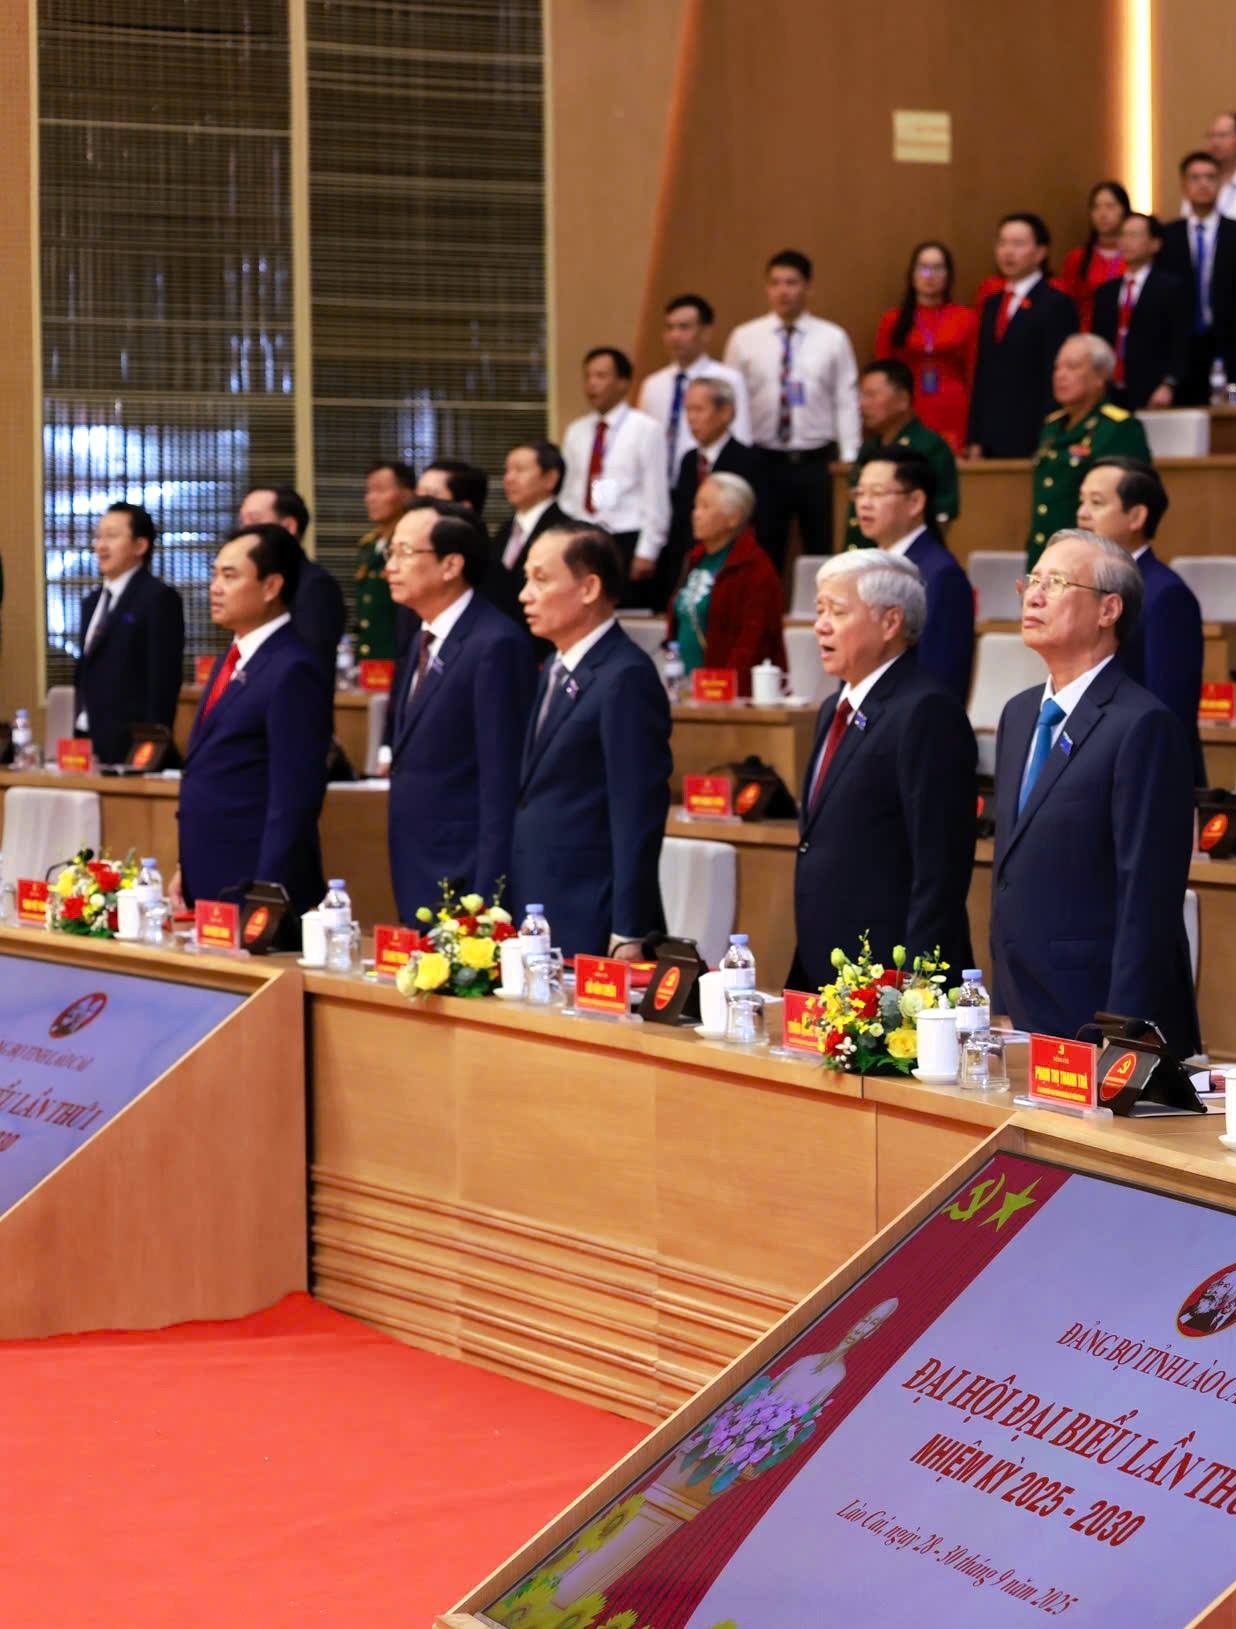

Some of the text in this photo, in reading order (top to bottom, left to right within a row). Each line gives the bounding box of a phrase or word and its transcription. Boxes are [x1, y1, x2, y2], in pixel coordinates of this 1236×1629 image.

[1056, 1320, 1118, 1357] ĐẢNG
[1103, 1338, 1145, 1371] BỘ
[1132, 1343, 1190, 1381] TỈNH
[1172, 1359, 1226, 1394] LÀO
[902, 1357, 971, 1404] ĐẠI
[947, 1374, 1022, 1423] HỘI
[998, 1393, 1073, 1441] ĐẠI
[1048, 1409, 1145, 1464] BIỂU
[1117, 1430, 1206, 1490] LẦN
[909, 1433, 994, 1482] NHIỆM
[973, 1456, 1026, 1494] KỲ
[1001, 1471, 1077, 1517] 2025
[1069, 1500, 1147, 1547] 2030
[836, 1499, 868, 1522] Lào
[861, 1510, 896, 1536] Cai,
[883, 1526, 921, 1551] ngày
[912, 1533, 944, 1555] 28
[936, 1544, 969, 1566] 30
[953, 1553, 999, 1587] tháng
[990, 1568, 1015, 1587] 9
[1000, 1577, 1039, 1601] năm
[1030, 1587, 1079, 1616] 2025
